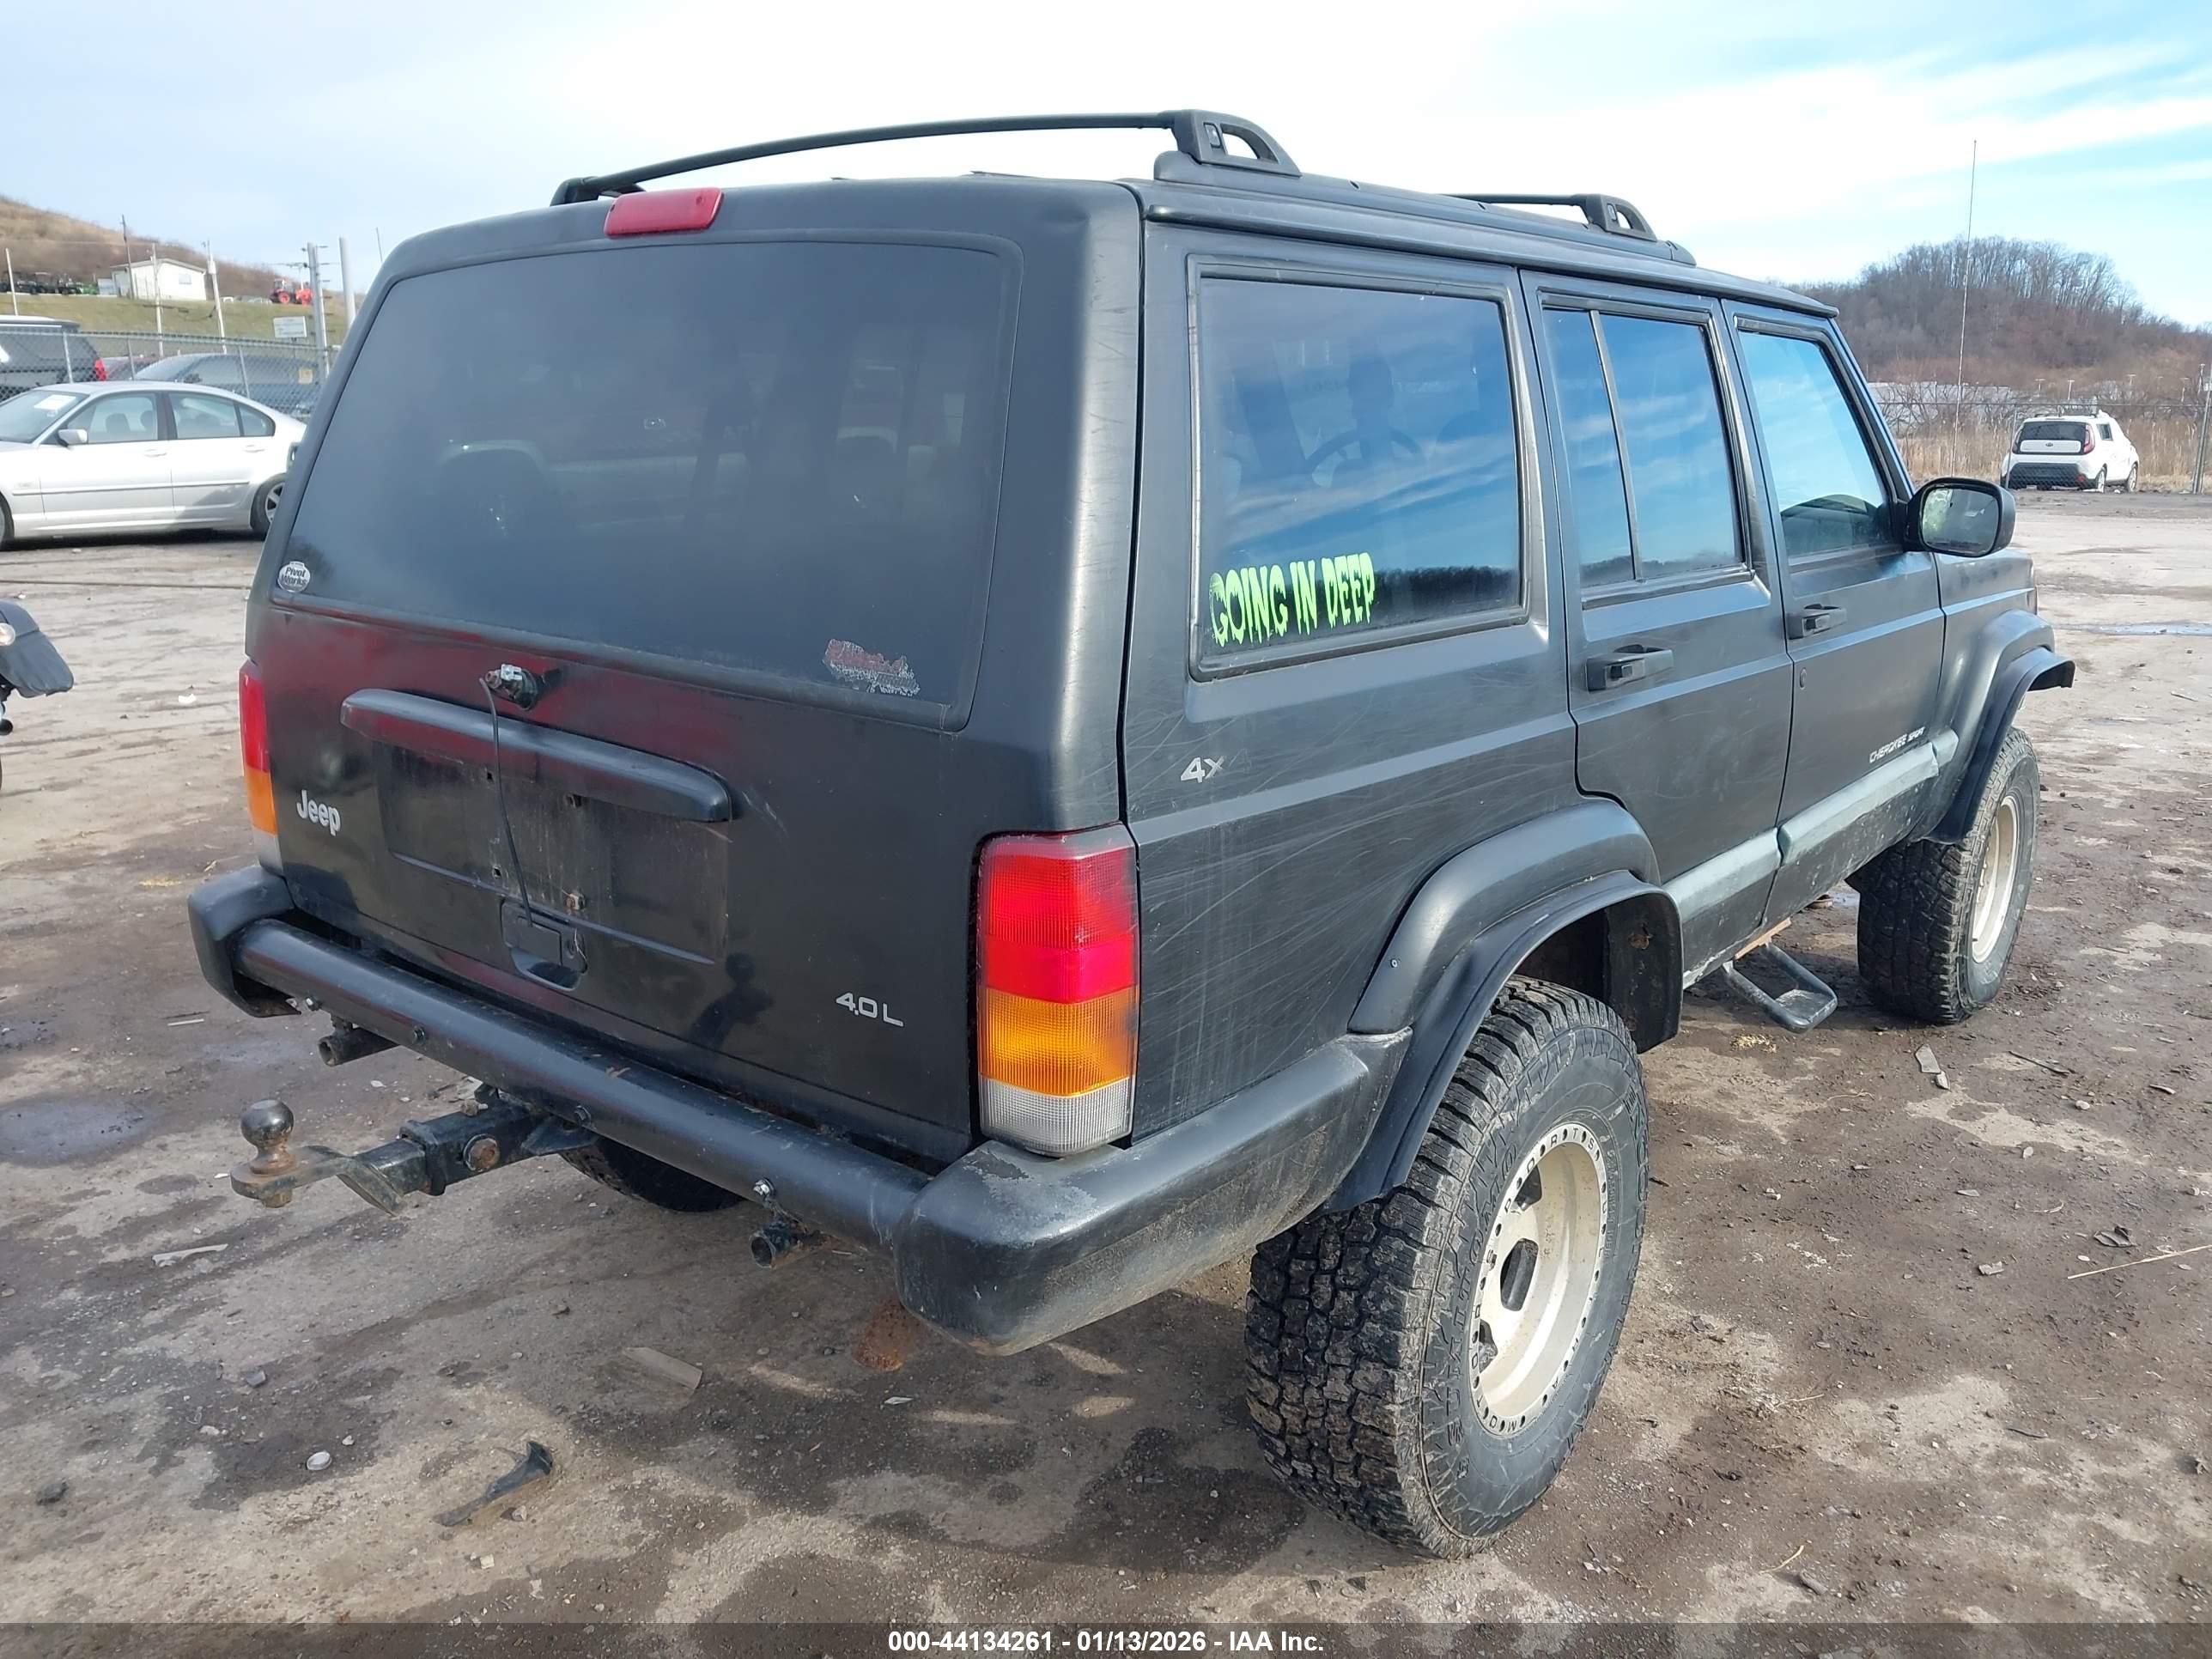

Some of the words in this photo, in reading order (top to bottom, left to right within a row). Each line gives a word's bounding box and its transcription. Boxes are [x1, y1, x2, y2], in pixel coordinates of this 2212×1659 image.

[285, 567, 306, 577] Pivot
[1209, 565, 1288, 647] GOING
[1290, 559, 1317, 635] IN
[1321, 552, 1375, 629] DEEP
[1869, 733, 1907, 763] CHEROKEE
[296, 789, 341, 836] Jeep
